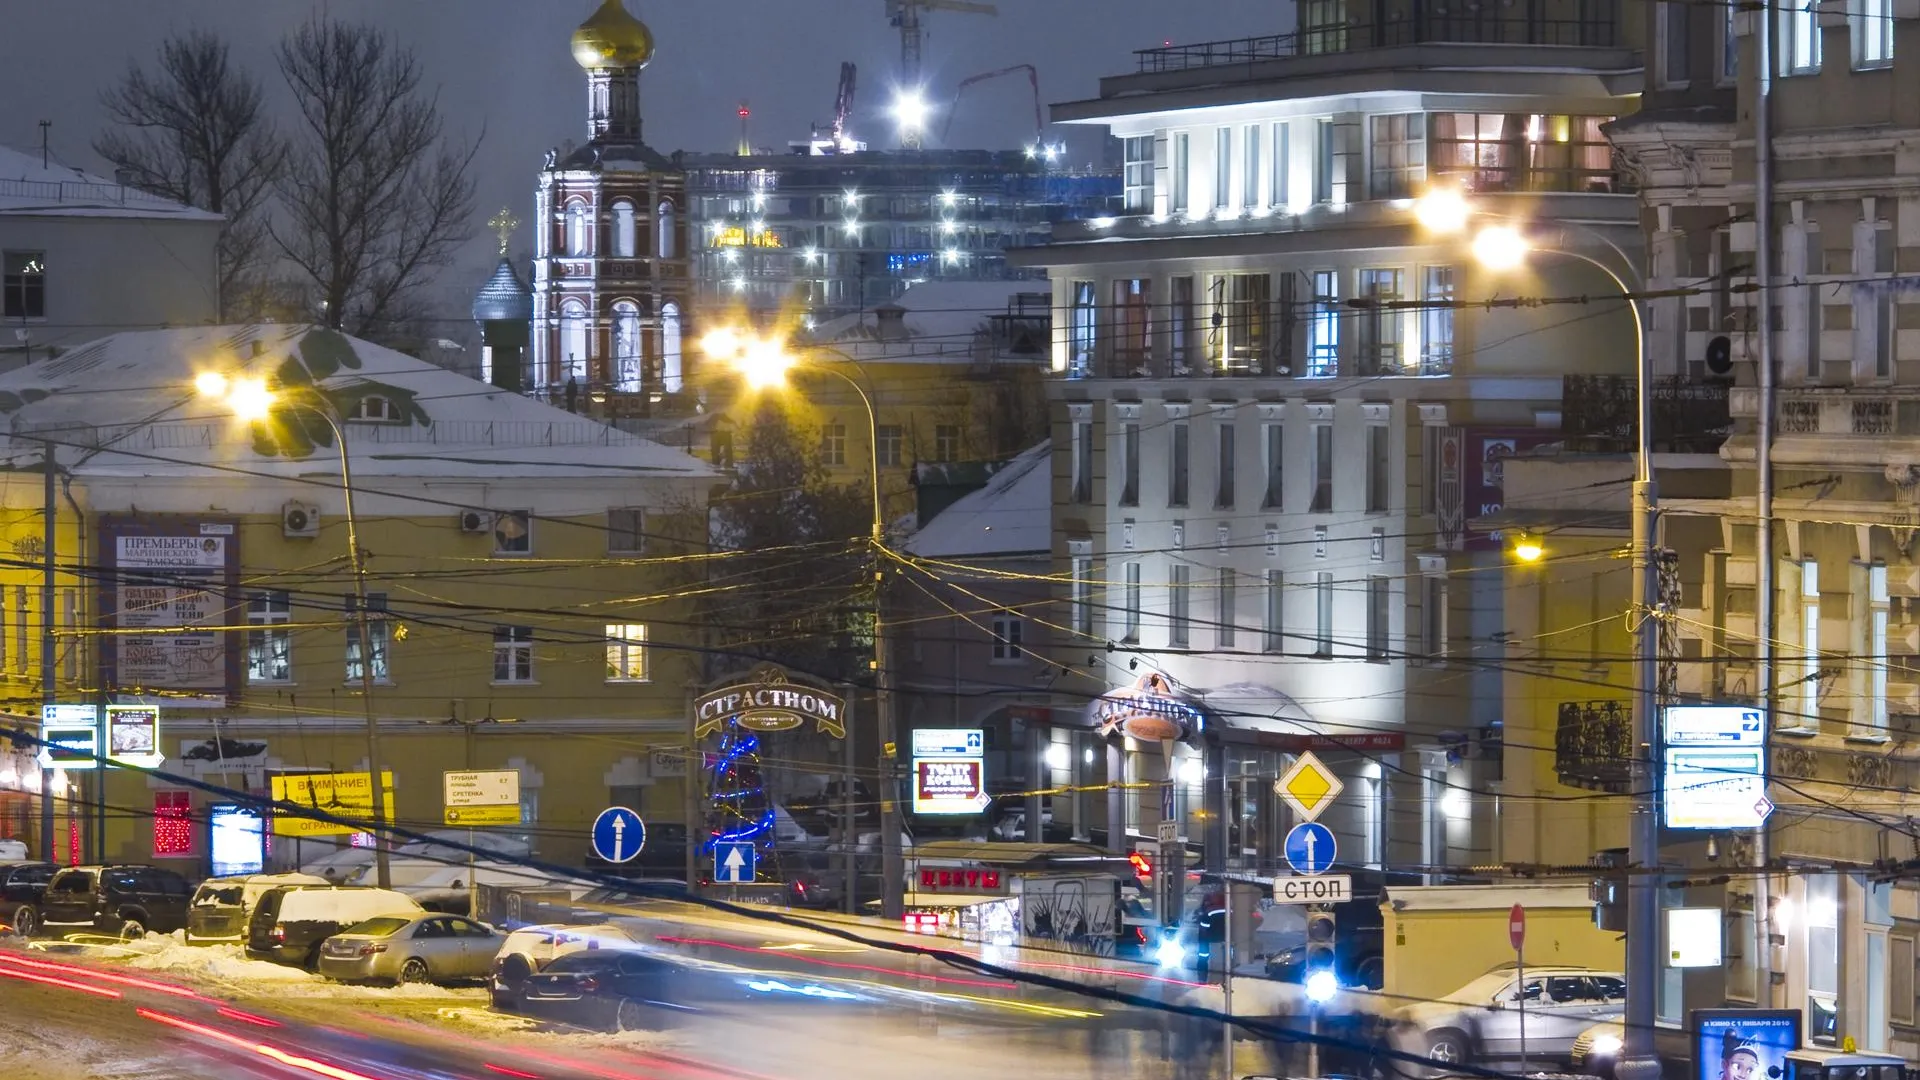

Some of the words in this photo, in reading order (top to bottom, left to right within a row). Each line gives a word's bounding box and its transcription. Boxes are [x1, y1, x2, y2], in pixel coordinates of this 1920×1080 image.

[125, 537, 199, 549] ПРЕМЬЕРЫ
[125, 599, 168, 611] ФИГАРО
[700, 690, 837, 720] СТРАСТНОМ
[926, 764, 971, 775] ТЕАТР
[921, 869, 999, 892] ЦВЕТЫ
[1285, 880, 1341, 899] СТОП
